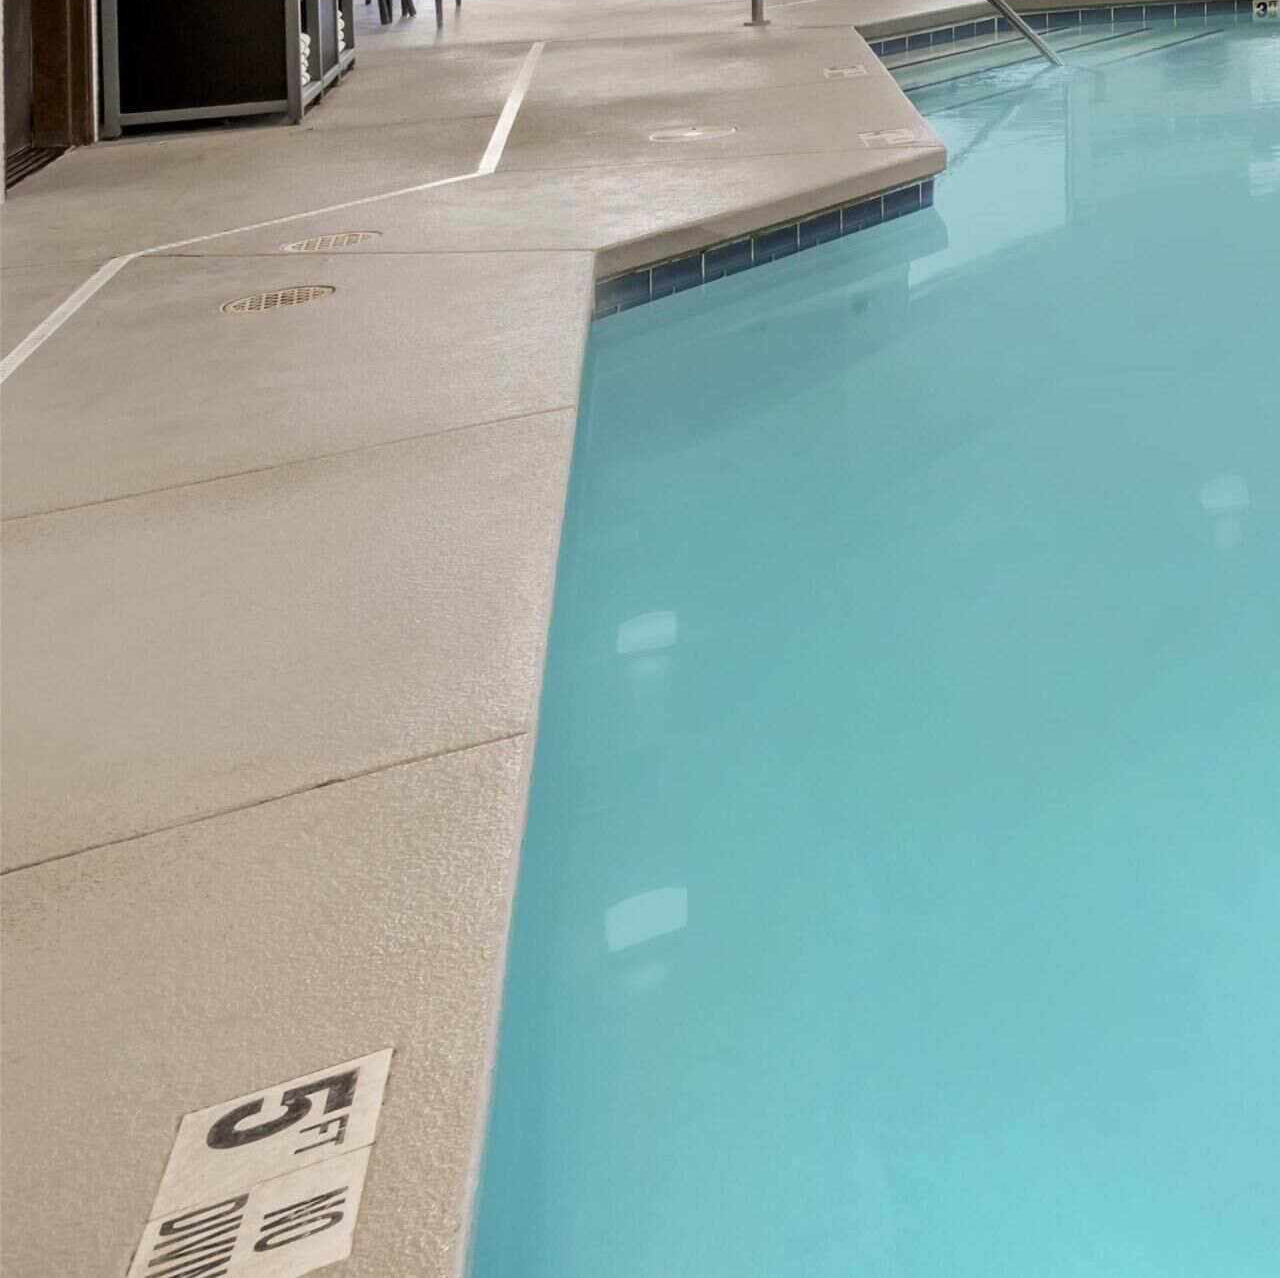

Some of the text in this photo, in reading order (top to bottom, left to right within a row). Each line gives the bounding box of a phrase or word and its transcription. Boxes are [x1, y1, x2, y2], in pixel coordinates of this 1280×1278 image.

[206, 1067, 360, 1155] 5 FT
[253, 1185, 349, 1252] NO
